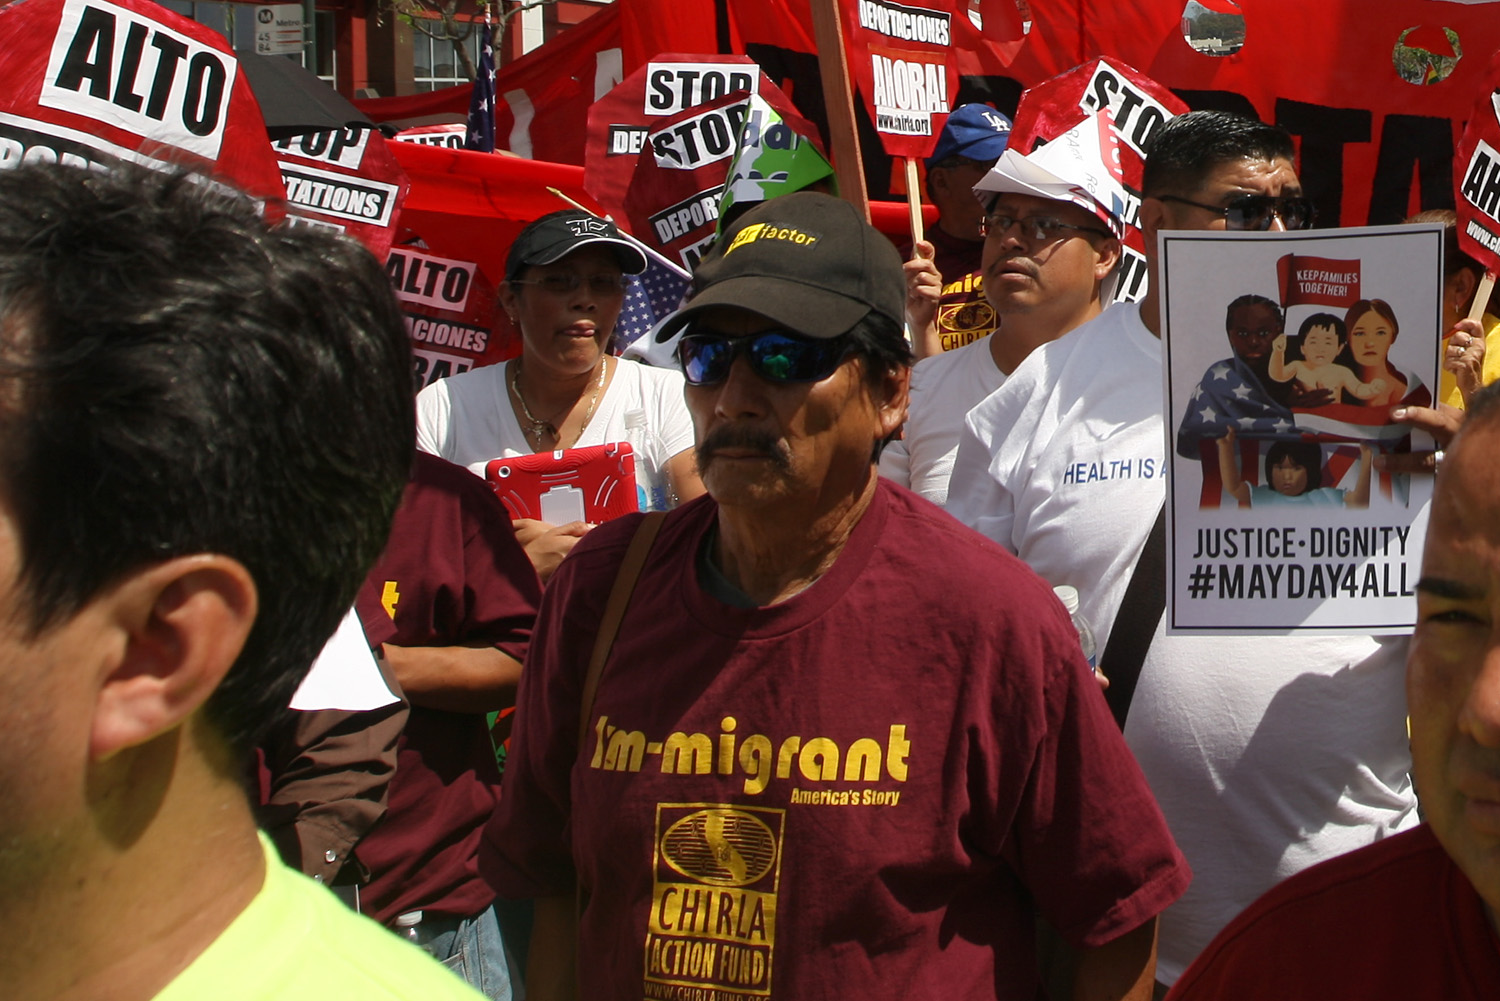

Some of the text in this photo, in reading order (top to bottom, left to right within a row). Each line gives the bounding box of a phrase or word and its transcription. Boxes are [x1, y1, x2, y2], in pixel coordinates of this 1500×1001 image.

[258, 33, 270, 42] 45
[54, 5, 227, 136] ALTO
[871, 54, 950, 114] AHORA!
[981, 111, 1011, 132] LA
[1086, 70, 1165, 154] STO
[760, 223, 816, 246] factor
[386, 252, 470, 303] ALTO
[1297, 270, 1358, 283] KEEP FAMILIES
[1300, 283, 1347, 296] TOGETHER!
[1064, 459, 1132, 484] HEALTH
[1138, 458, 1154, 479] IS
[1188, 563, 1415, 600] #MAYDAY4ALL
[590, 716, 911, 795] I'm-migrant
[791, 787, 900, 807] America's Story
[658, 887, 767, 941] CHIRLA
[650, 938, 764, 986] ACTION FUND
